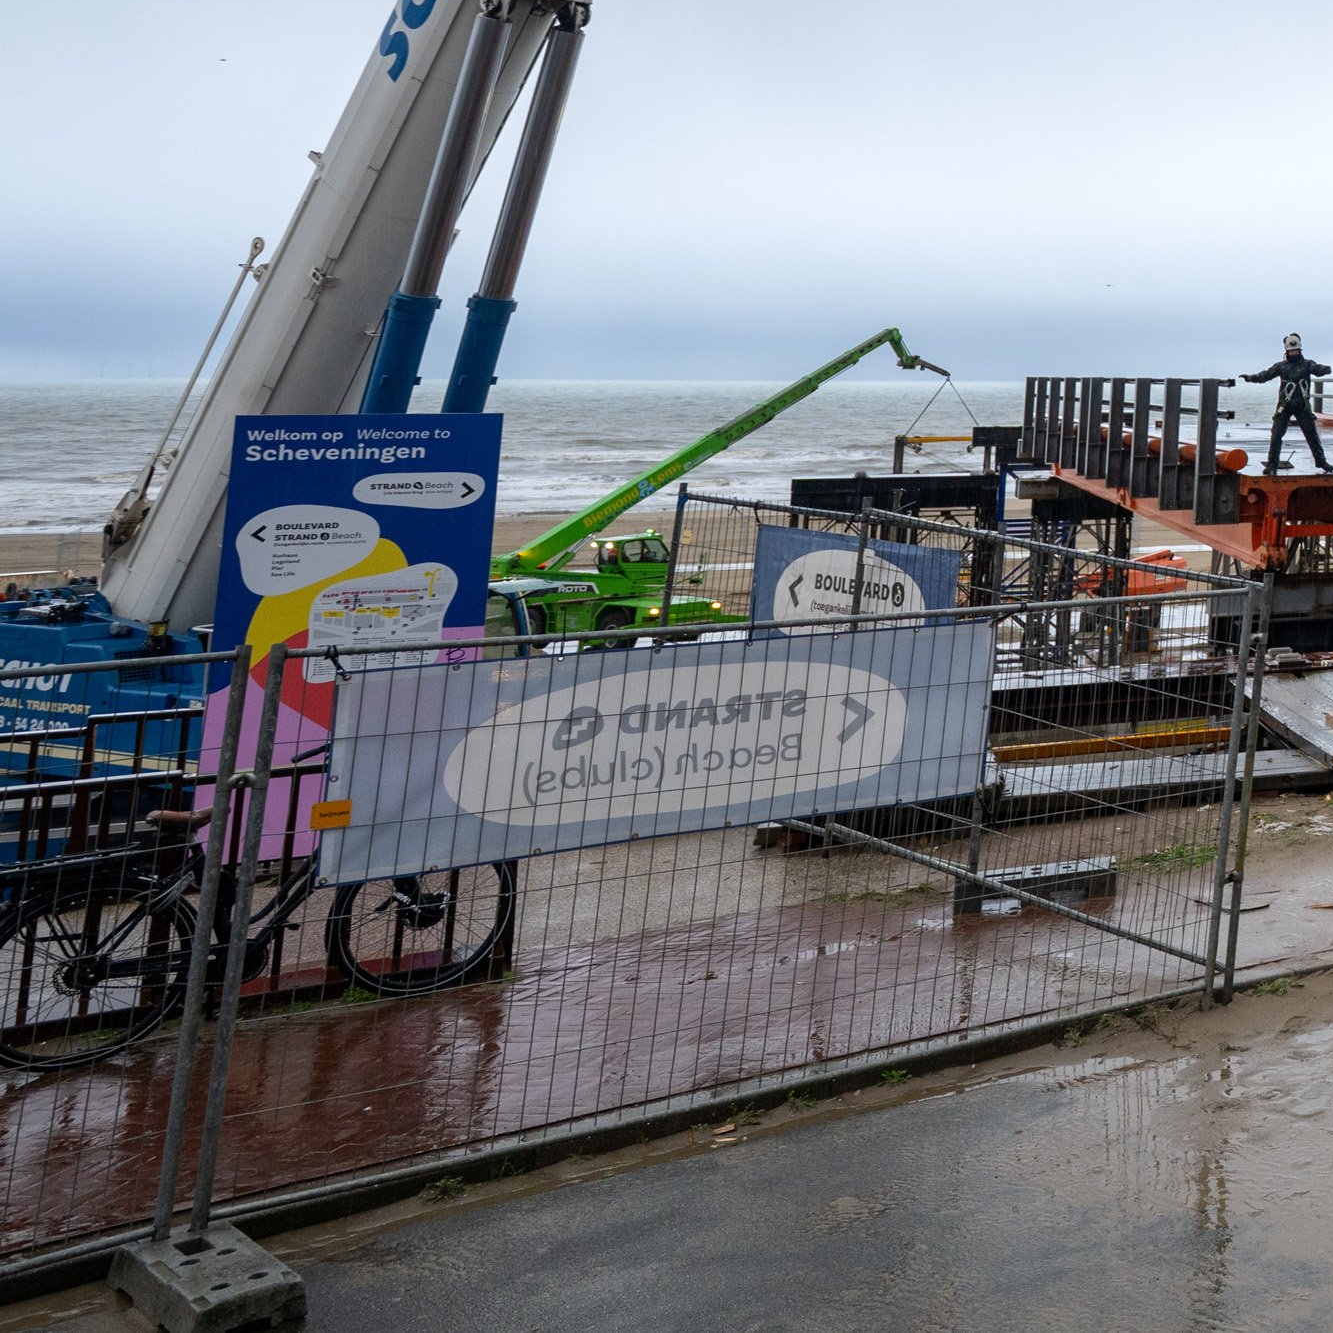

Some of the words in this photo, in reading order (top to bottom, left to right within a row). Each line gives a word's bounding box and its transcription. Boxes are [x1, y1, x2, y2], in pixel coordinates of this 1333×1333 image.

[247, 429, 317, 441] Welkom
[321, 431, 343, 442] op
[357, 428, 430, 440] Welcome
[434, 429, 450, 439] to
[245, 444, 426, 463] Scheveningen
[370, 482, 412, 490] STRAND
[424, 481, 453, 490] Beach
[275, 522, 339, 530] BOULEVARD
[331, 531, 362, 540] Beach
[558, 585, 588, 593] ROTO
[814, 573, 890, 601] BOULEARD
[26, 700, 92, 715] TRANSPORT
